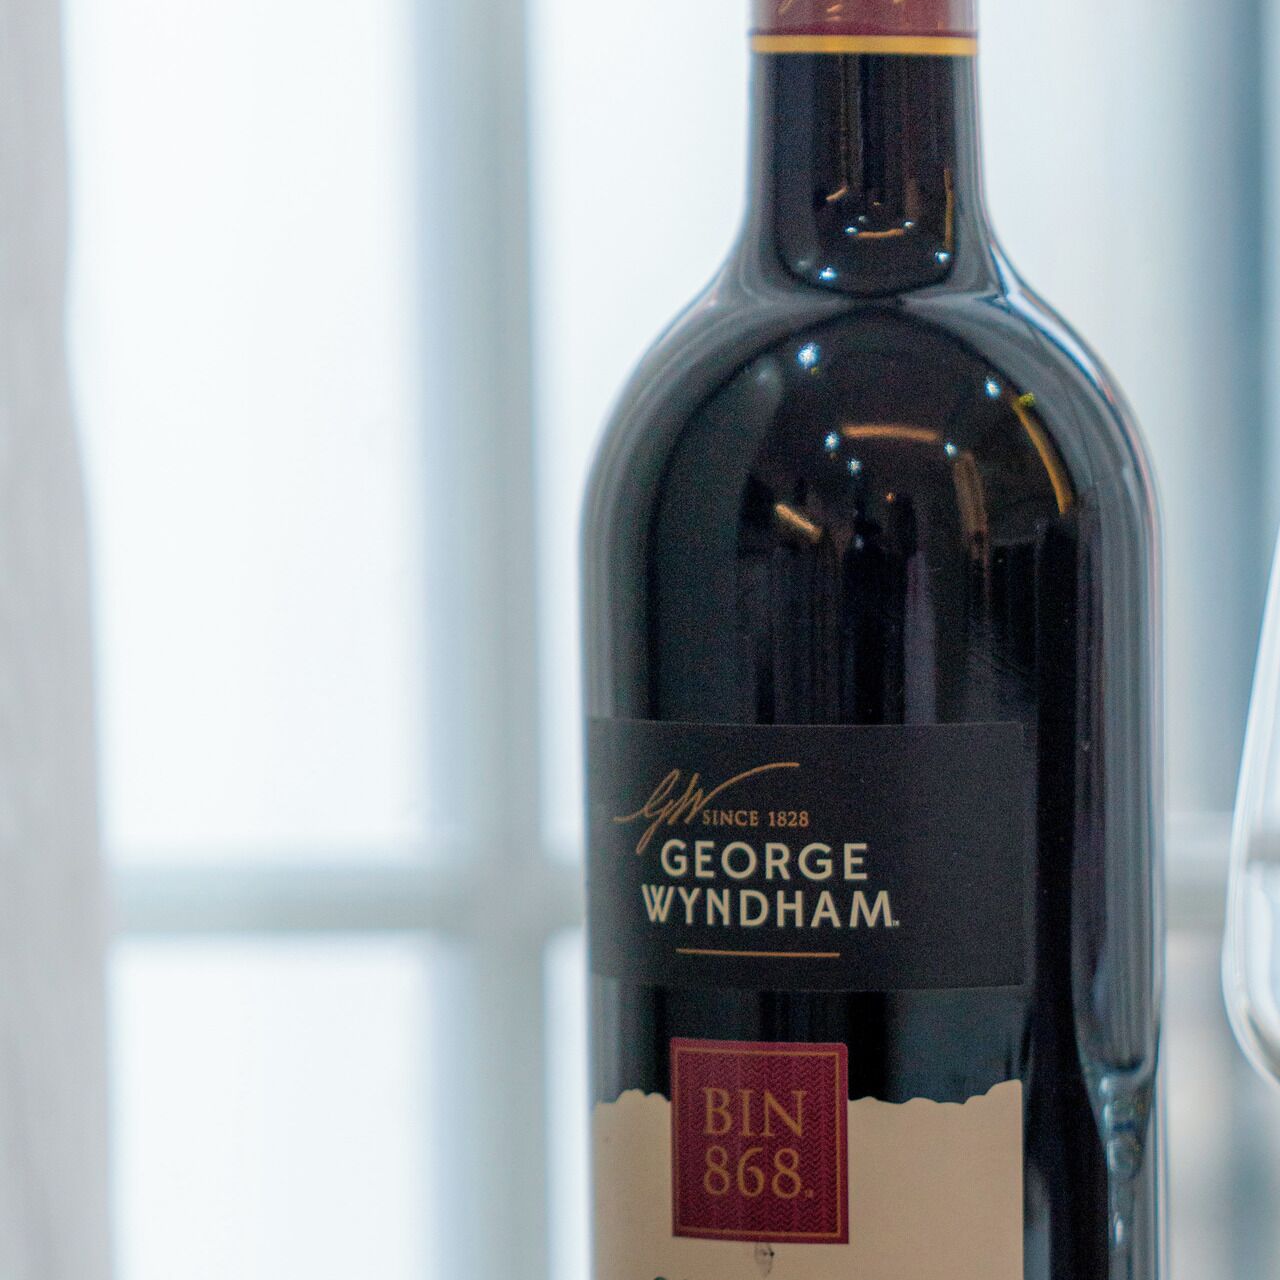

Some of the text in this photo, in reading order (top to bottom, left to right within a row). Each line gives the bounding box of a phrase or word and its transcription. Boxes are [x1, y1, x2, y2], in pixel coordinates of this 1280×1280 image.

[703, 810, 810, 828] SINCE 1828
[661, 839, 868, 881] GEORGE
[641, 884, 892, 928] WYNDHAM
[703, 1086, 808, 1138] BIN
